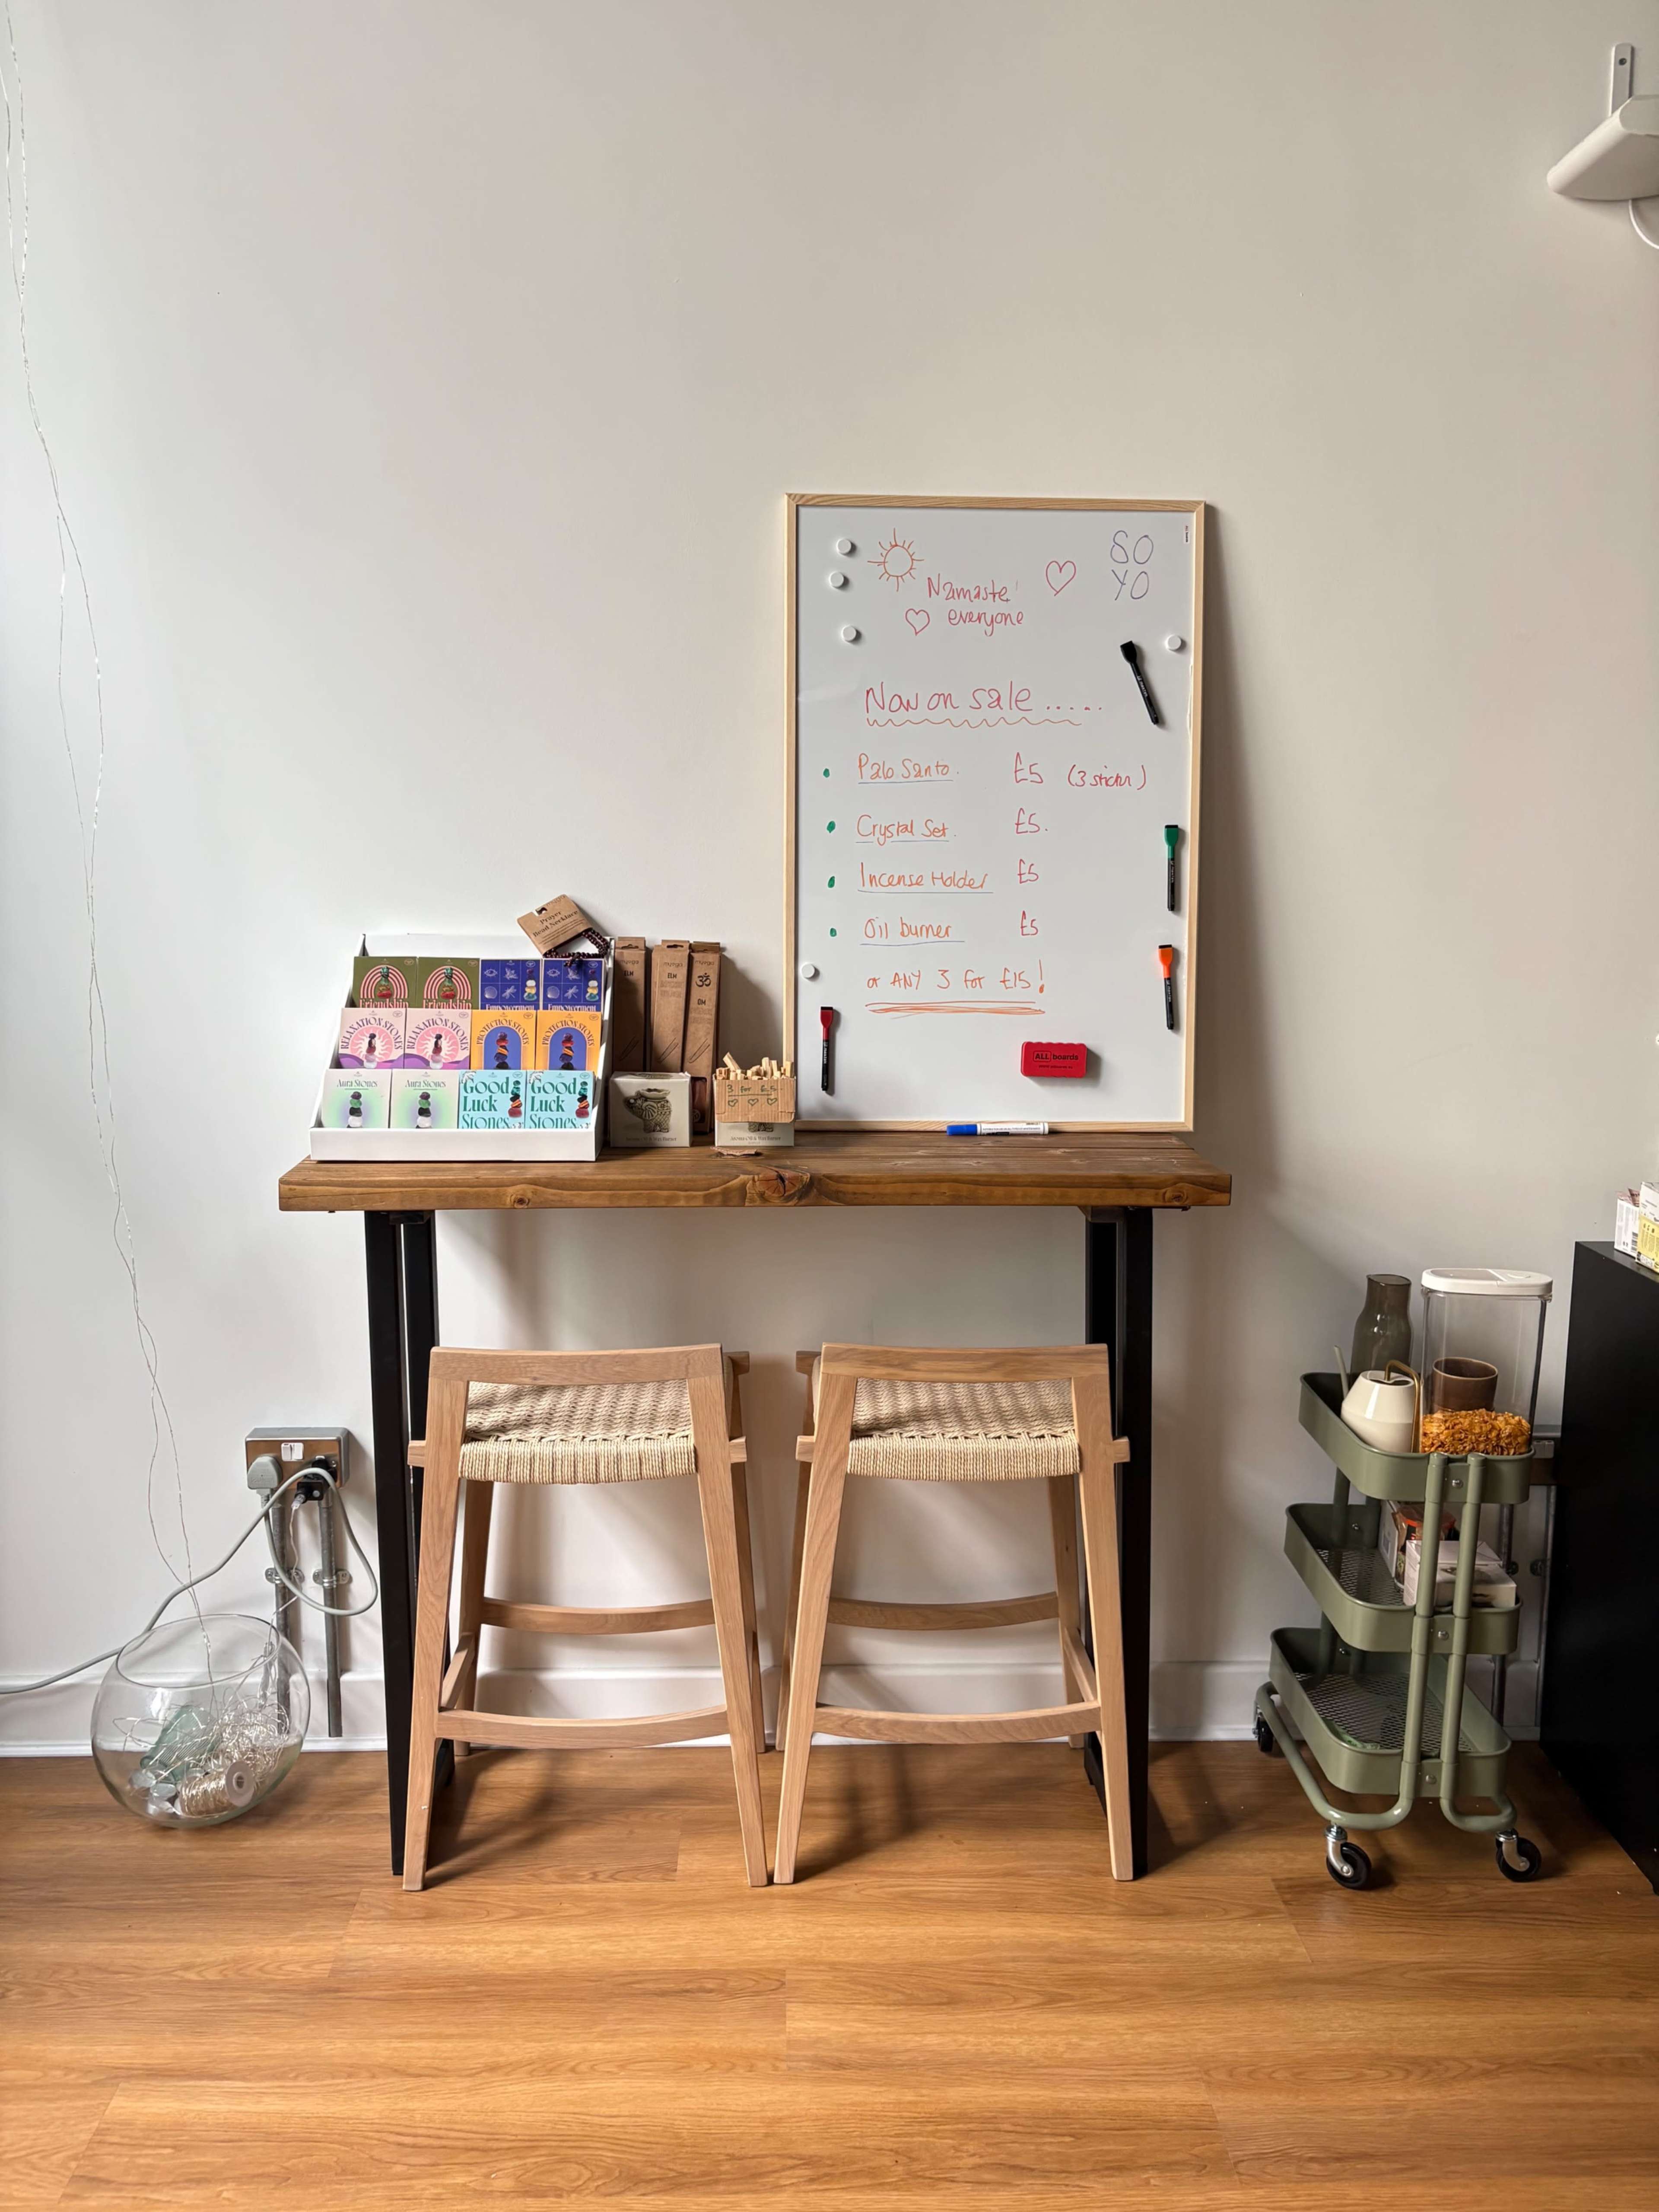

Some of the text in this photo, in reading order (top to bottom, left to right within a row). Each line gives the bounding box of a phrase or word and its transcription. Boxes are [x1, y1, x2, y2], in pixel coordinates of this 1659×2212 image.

[1110, 530, 1154, 564] SO
[1111, 569, 1150, 601] YO
[948, 609, 1023, 637] everyone
[865, 681, 918, 713] Now
[928, 692, 960, 711] on
[858, 753, 894, 780] Palo
[1014, 752, 1043, 783] £5
[857, 814, 915, 846] Crystal
[861, 858, 1039, 889] Incense Holder £5
[533, 924, 550, 937] Bead
[550, 910, 578, 929] Necklace
[540, 911, 562, 924] Prayer
[864, 910, 1039, 939] Oil burner £5
[867, 977, 880, 989] or
[890, 969, 921, 990] ANY
[937, 969, 950, 989] 3
[964, 969, 985, 989] for
[340, 1016, 403, 1050] RELAXATION STONES
[407, 1017, 469, 1051] RELAXATION STONES
[476, 1018, 529, 1045] PROTECTION STONES
[542, 1019, 595, 1046] PROTECTION STONES
[337, 1079, 378, 1088] Aura Stones
[405, 1079, 421, 1088] Aura
[463, 1077, 509, 1094] Good
[531, 1077, 577, 1095] Good
[727, 1084, 734, 1093] 3
[463, 1095, 498, 1112] Luck
[530, 1095, 565, 1112] Luck
[462, 1114, 509, 1129] Stones
[529, 1114, 577, 1129] Stones
